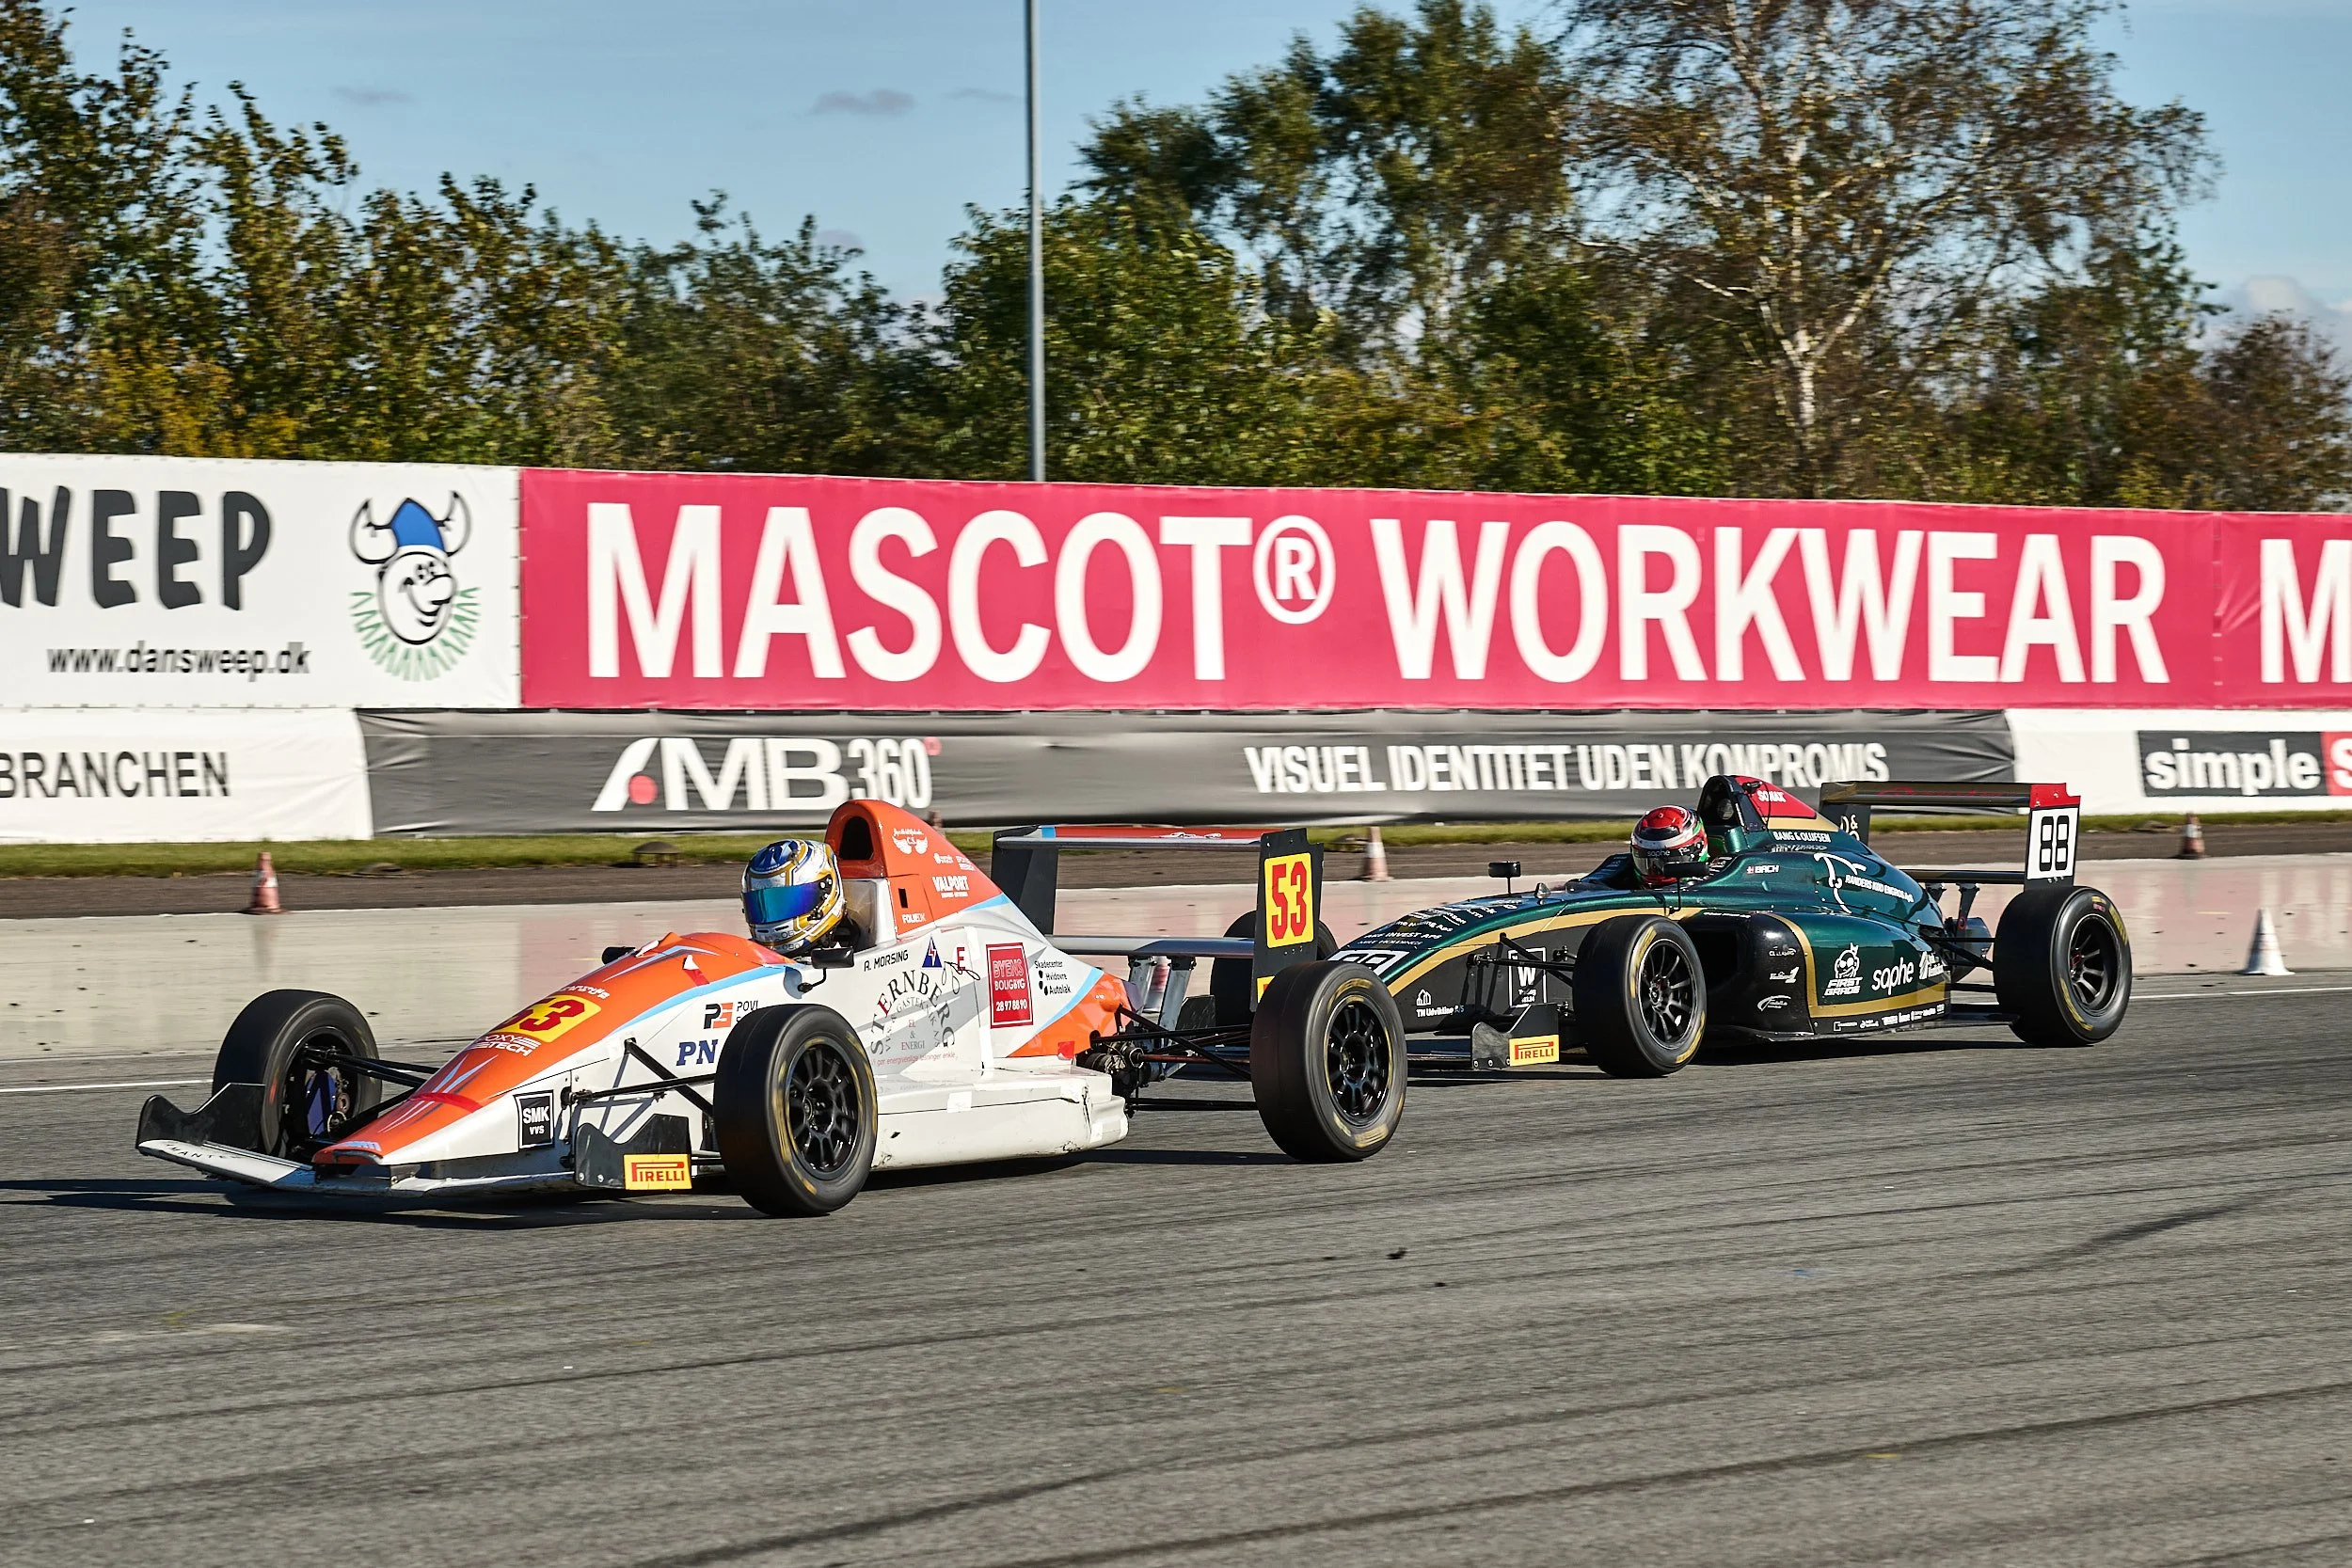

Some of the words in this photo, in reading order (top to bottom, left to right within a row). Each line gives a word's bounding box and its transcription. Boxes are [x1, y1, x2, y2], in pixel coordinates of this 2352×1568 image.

[0, 484, 271, 611] WEEP
[1370, 518, 2169, 685] WORKWEAR
[47, 641, 311, 683] www.dansweep.dk
[0, 752, 230, 798] BRANCHEN
[1244, 745, 1387, 793] VISUEL
[1387, 744, 1572, 791] IDENTITET
[1576, 743, 1677, 790] UDEN
[1680, 742, 1890, 789] KOMPROMIS
[2145, 737, 2321, 796] simple
[2040, 815, 2070, 871] 88
[1271, 861, 1308, 940] 53
[874, 950, 909, 969] MORSING
[1827, 976, 1863, 988] FIRST
[1515, 1040, 1554, 1060] PIRELLI
[522, 1105, 550, 1124] SMK
[631, 1161, 685, 1182] PIRELLI
